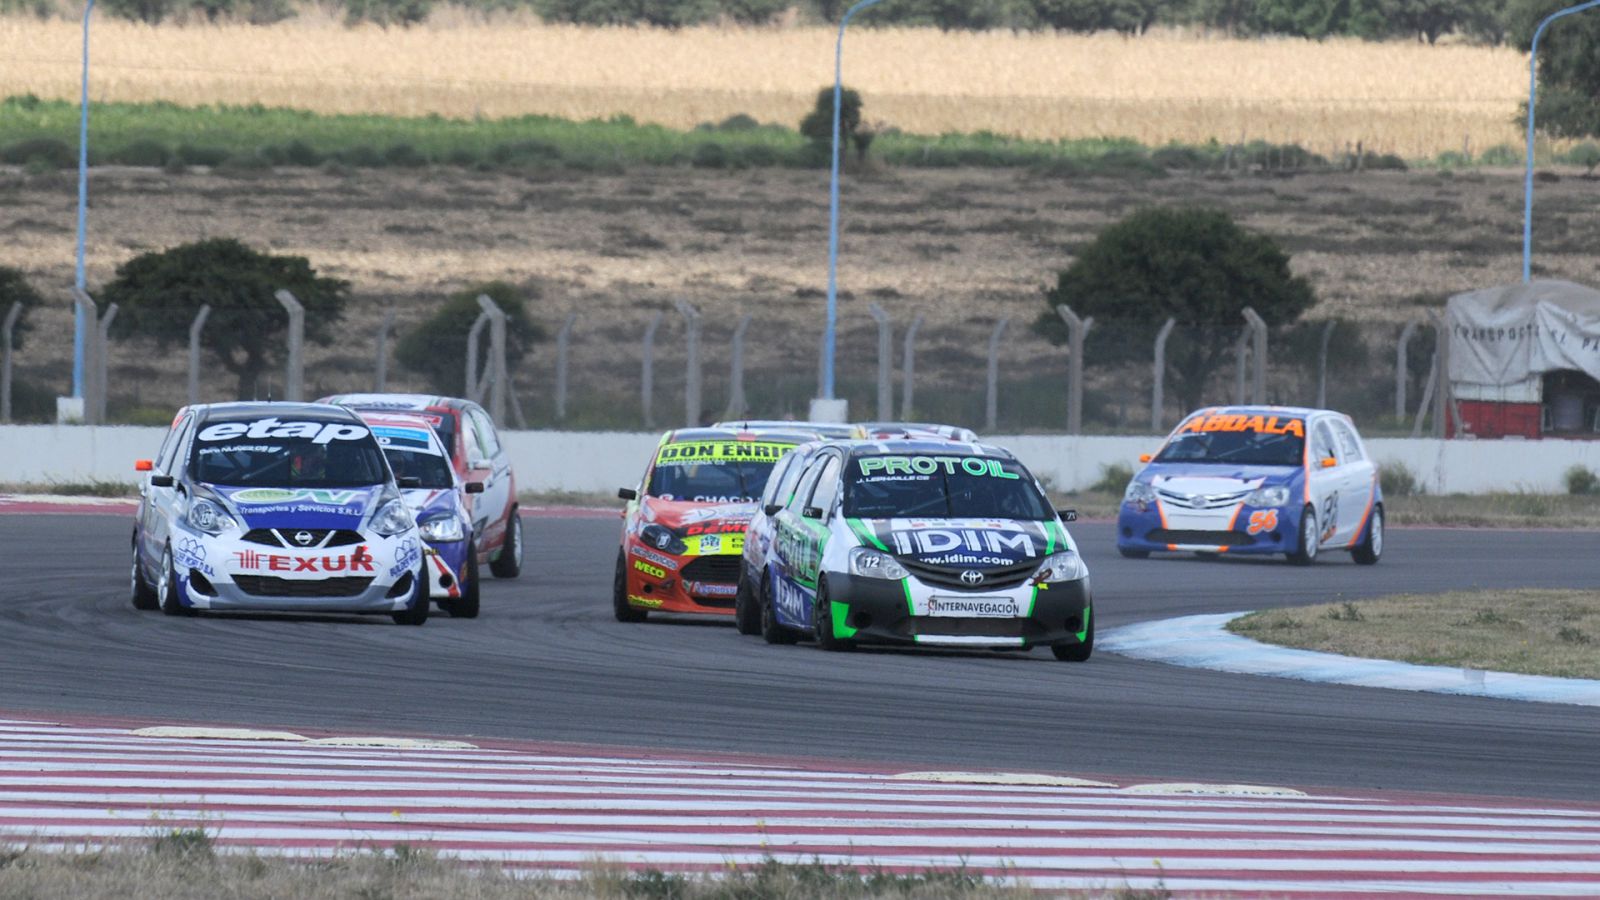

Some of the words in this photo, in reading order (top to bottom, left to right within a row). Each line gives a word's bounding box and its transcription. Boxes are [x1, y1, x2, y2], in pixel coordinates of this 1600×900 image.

[198, 417, 370, 444] etap
[1176, 414, 1305, 438] ABDALA
[661, 445, 714, 458] DON
[858, 456, 1020, 480] PROTOIL
[297, 504, 336, 514] Servicios
[1247, 508, 1279, 535] 56
[892, 530, 1037, 557] IDIM
[634, 560, 666, 579] IVECO
[864, 557, 880, 568] 12
[934, 599, 1020, 614] INTERNAVEGACION
